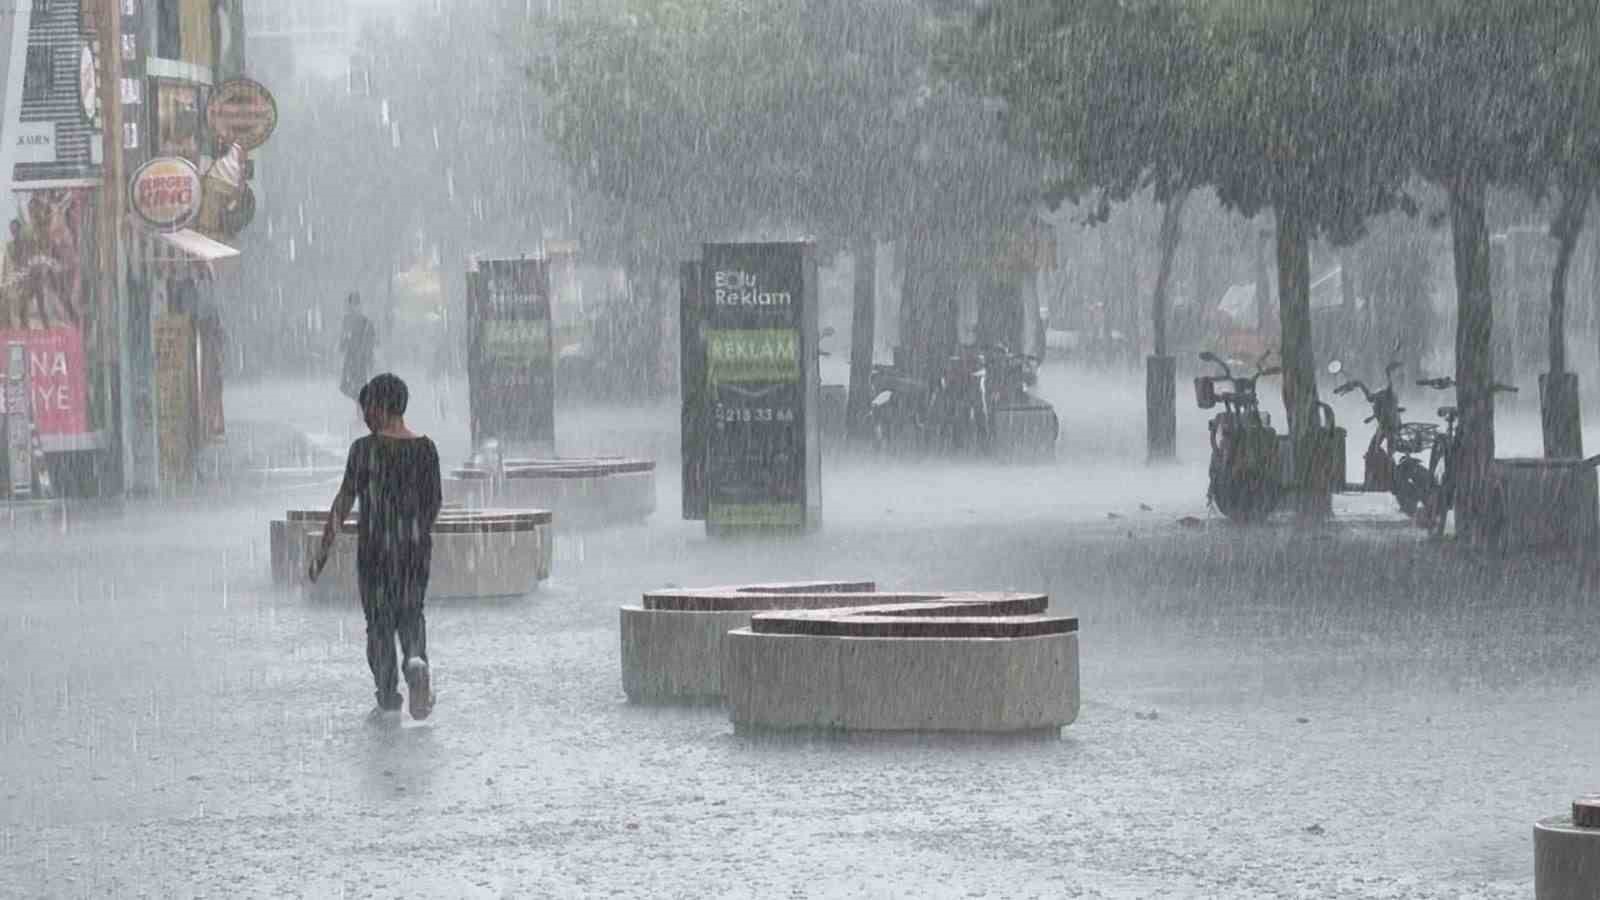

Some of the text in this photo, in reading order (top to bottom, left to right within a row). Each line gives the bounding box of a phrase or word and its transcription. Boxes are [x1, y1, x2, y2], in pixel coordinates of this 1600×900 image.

[139, 176, 193, 192] BURGER
[715, 288, 791, 305] Reklam
[711, 338, 795, 360] REKLAM
[32, 352, 67, 376] NA
